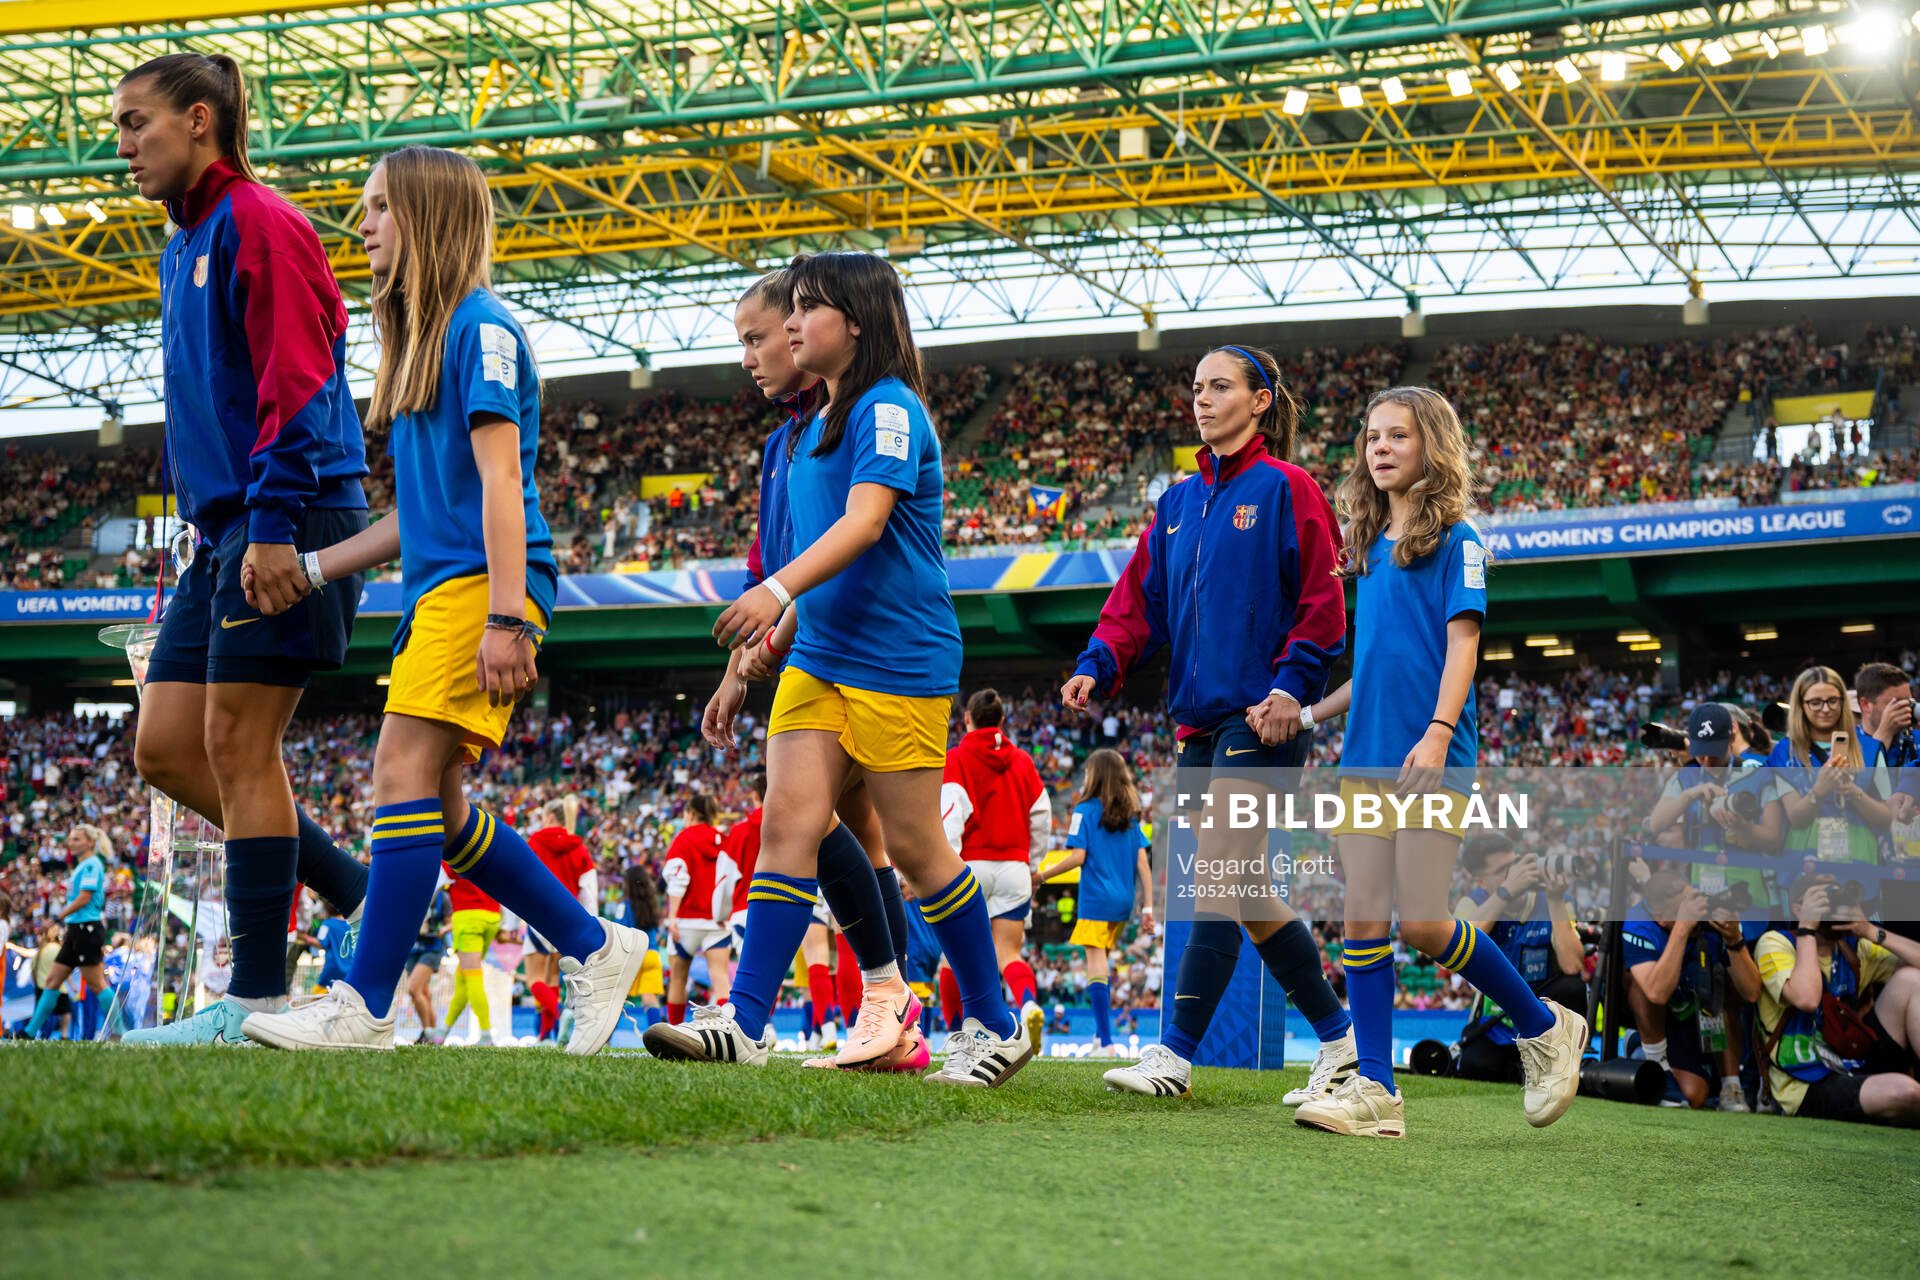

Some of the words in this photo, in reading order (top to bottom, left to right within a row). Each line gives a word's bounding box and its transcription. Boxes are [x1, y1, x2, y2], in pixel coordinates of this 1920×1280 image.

[1515, 525, 1614, 549] WOMEN'S
[1619, 515, 1754, 543] CHAMPIONS
[1760, 509, 1846, 534] LEAGUE
[17, 597, 58, 613] UEFA
[62, 595, 142, 612] WOMEN'S
